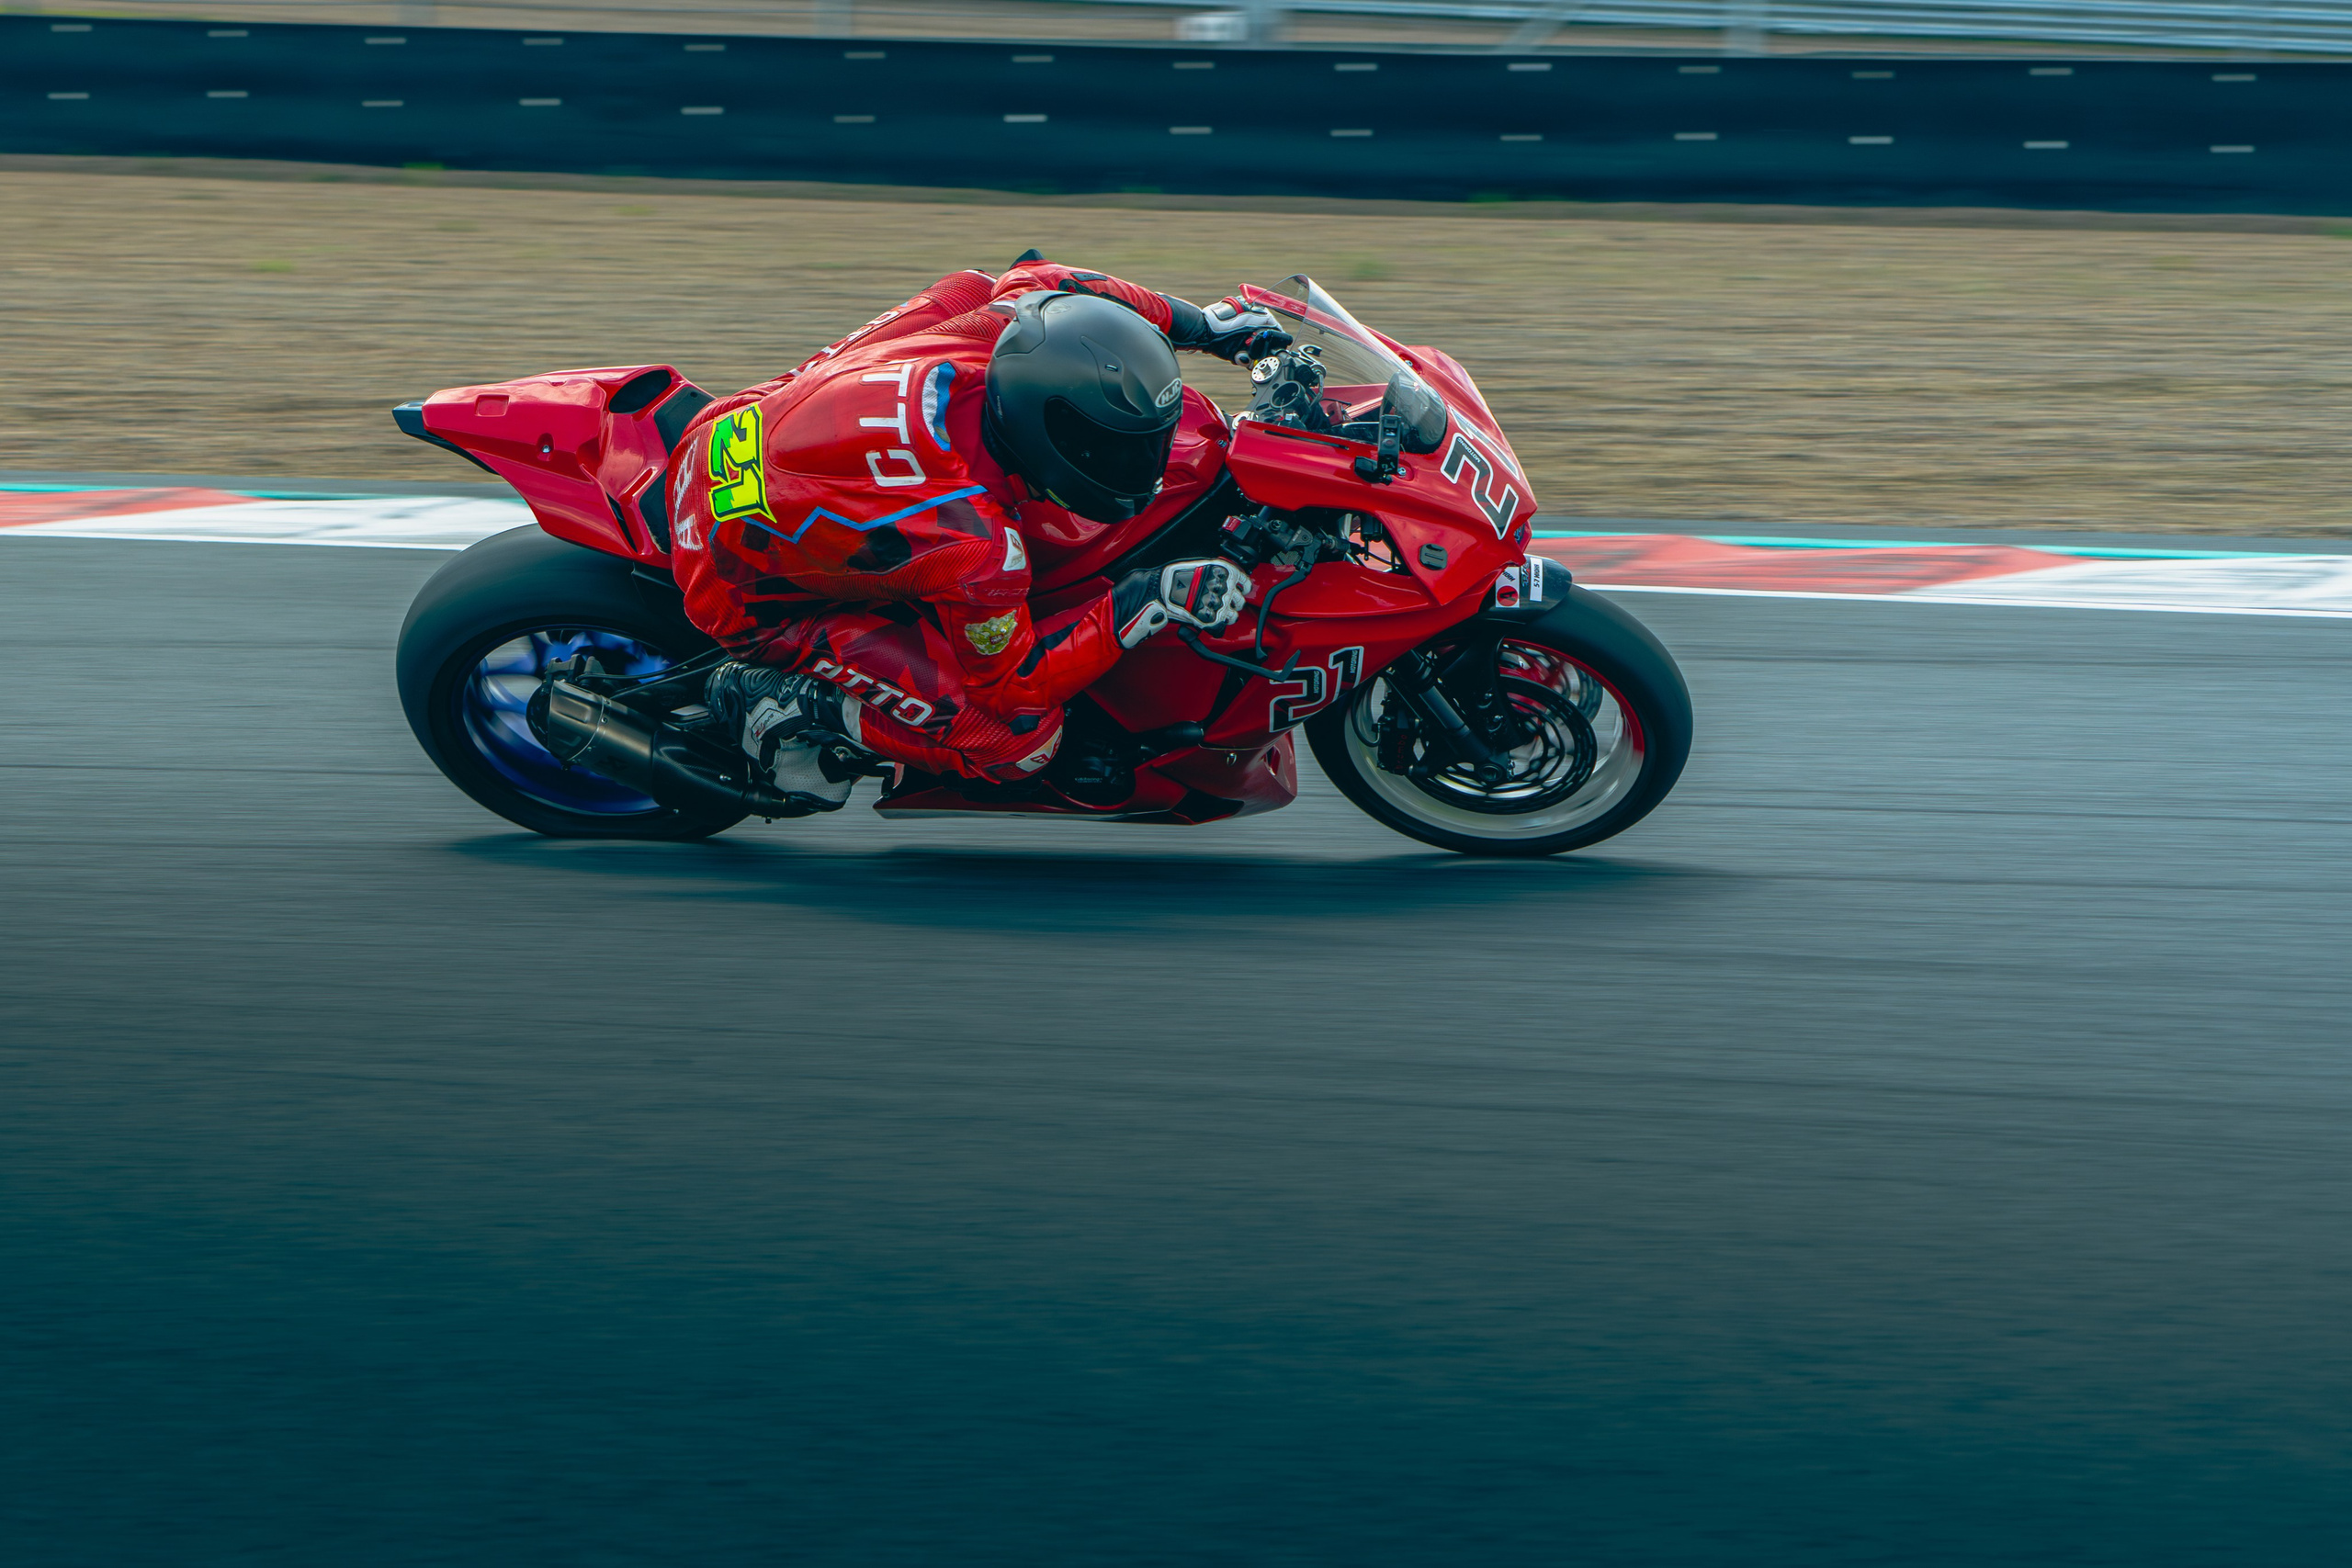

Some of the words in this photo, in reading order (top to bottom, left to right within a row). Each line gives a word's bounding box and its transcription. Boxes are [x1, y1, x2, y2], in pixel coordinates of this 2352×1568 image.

[858, 357, 927, 488] TTO
[1159, 379, 1182, 406] HJC
[708, 403, 777, 524] 21
[1457, 436, 1481, 463] MOTORING
[813, 660, 933, 727] OTTO
[1269, 646, 1364, 732] 21
